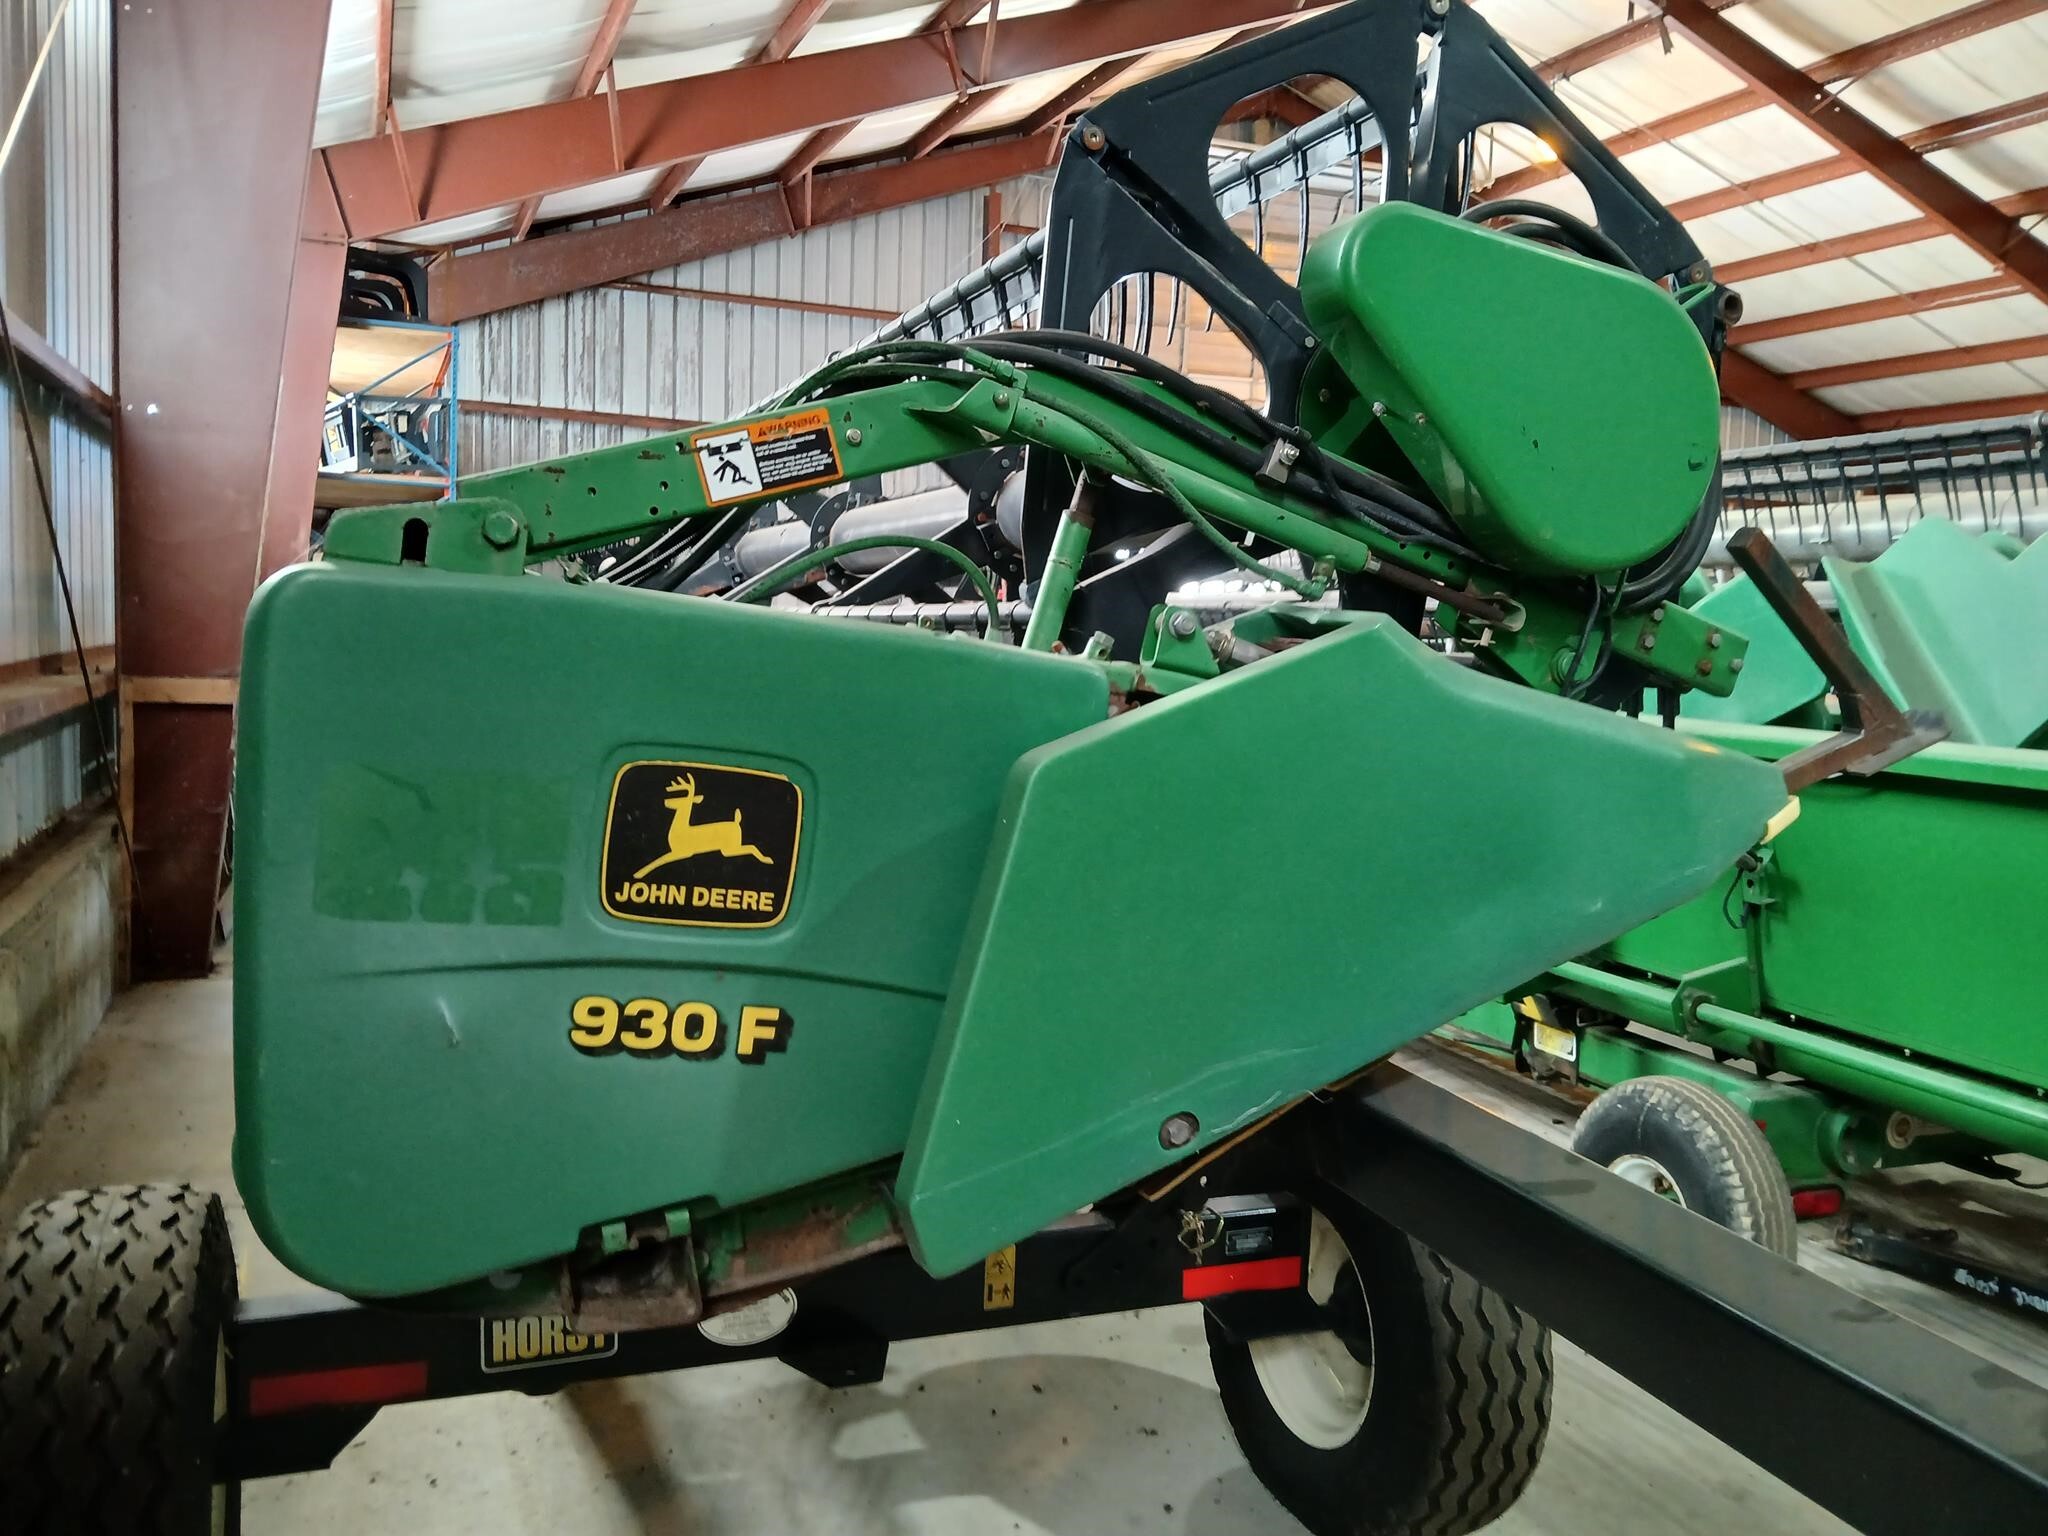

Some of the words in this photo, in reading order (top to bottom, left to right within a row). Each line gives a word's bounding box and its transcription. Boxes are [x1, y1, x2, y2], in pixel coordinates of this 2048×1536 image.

[614, 881, 687, 906] JOHN
[691, 885, 775, 913] DEERE
[569, 994, 721, 1056] 930
[736, 1004, 784, 1058] F
